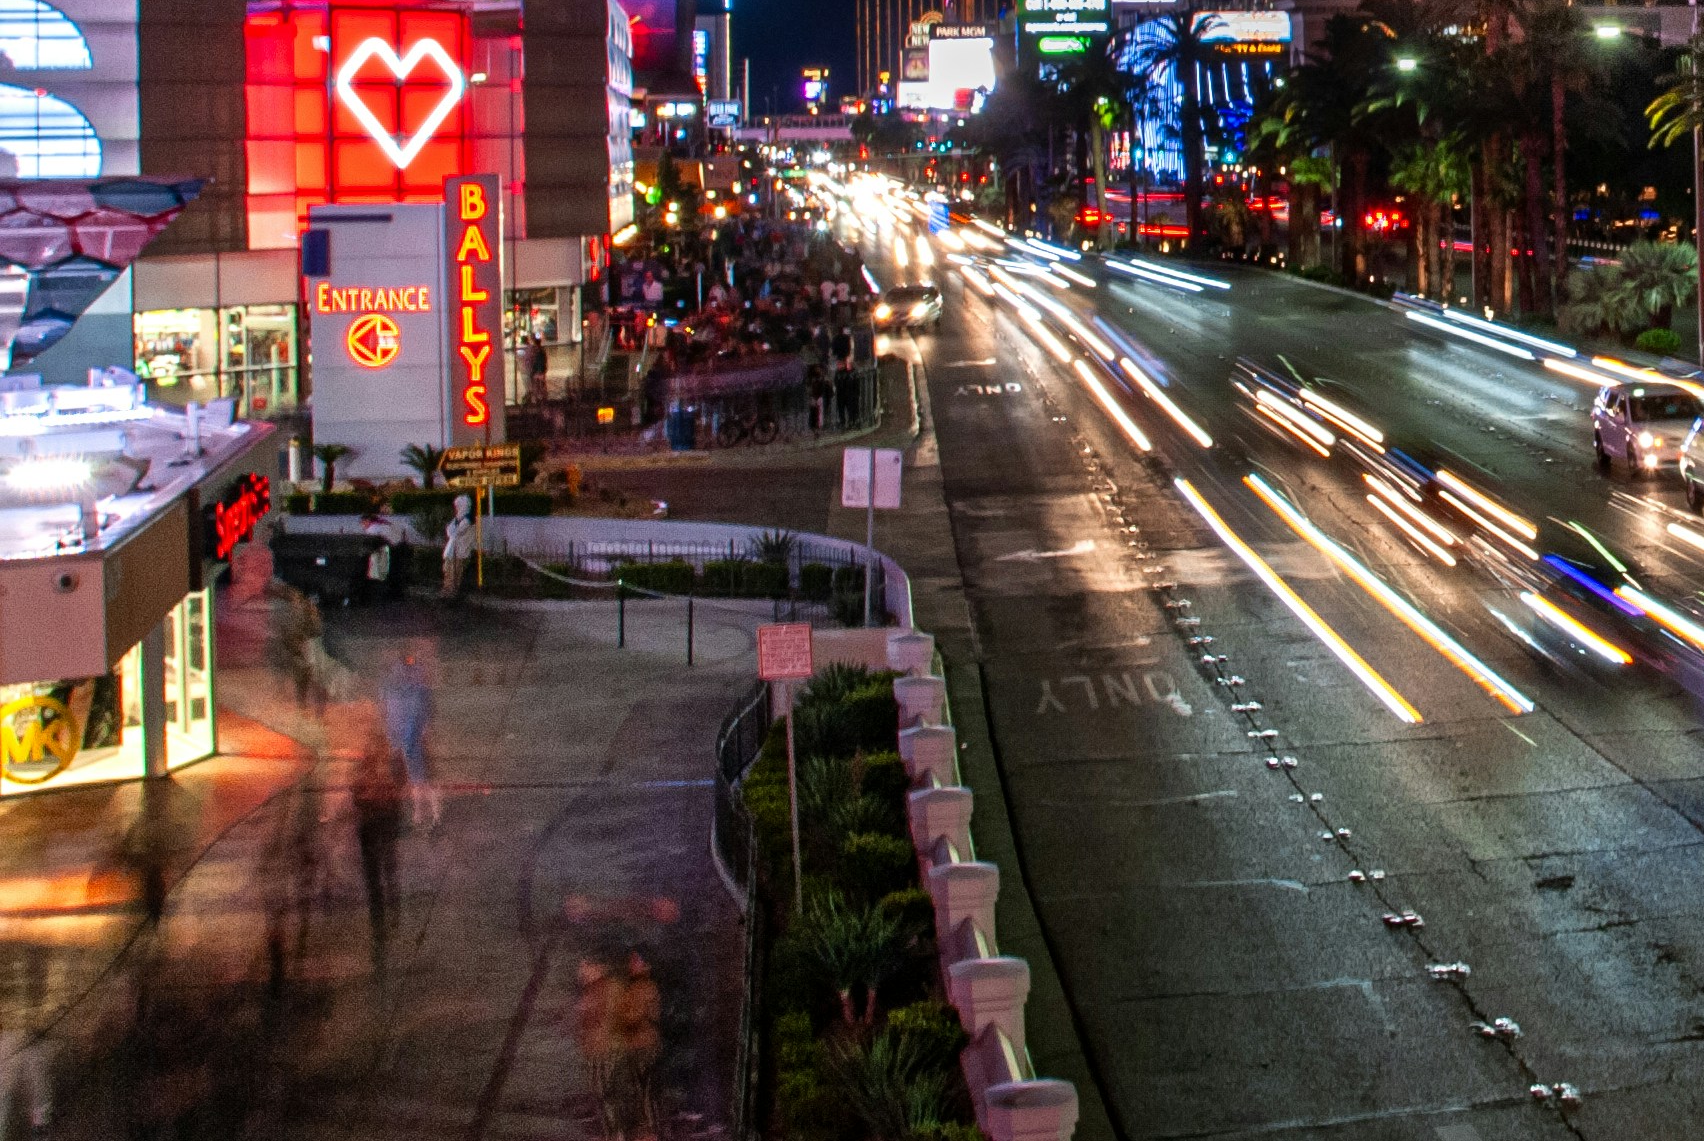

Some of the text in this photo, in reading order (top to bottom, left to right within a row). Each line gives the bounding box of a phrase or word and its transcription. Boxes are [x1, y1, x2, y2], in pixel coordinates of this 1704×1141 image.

[936, 25, 986, 38] PARK MGM
[317, 283, 431, 313] ENTRANCE
[457, 182, 491, 425] BALLYS
[1036, 672, 1178, 715] ONLY
[0, 719, 68, 764] MK
